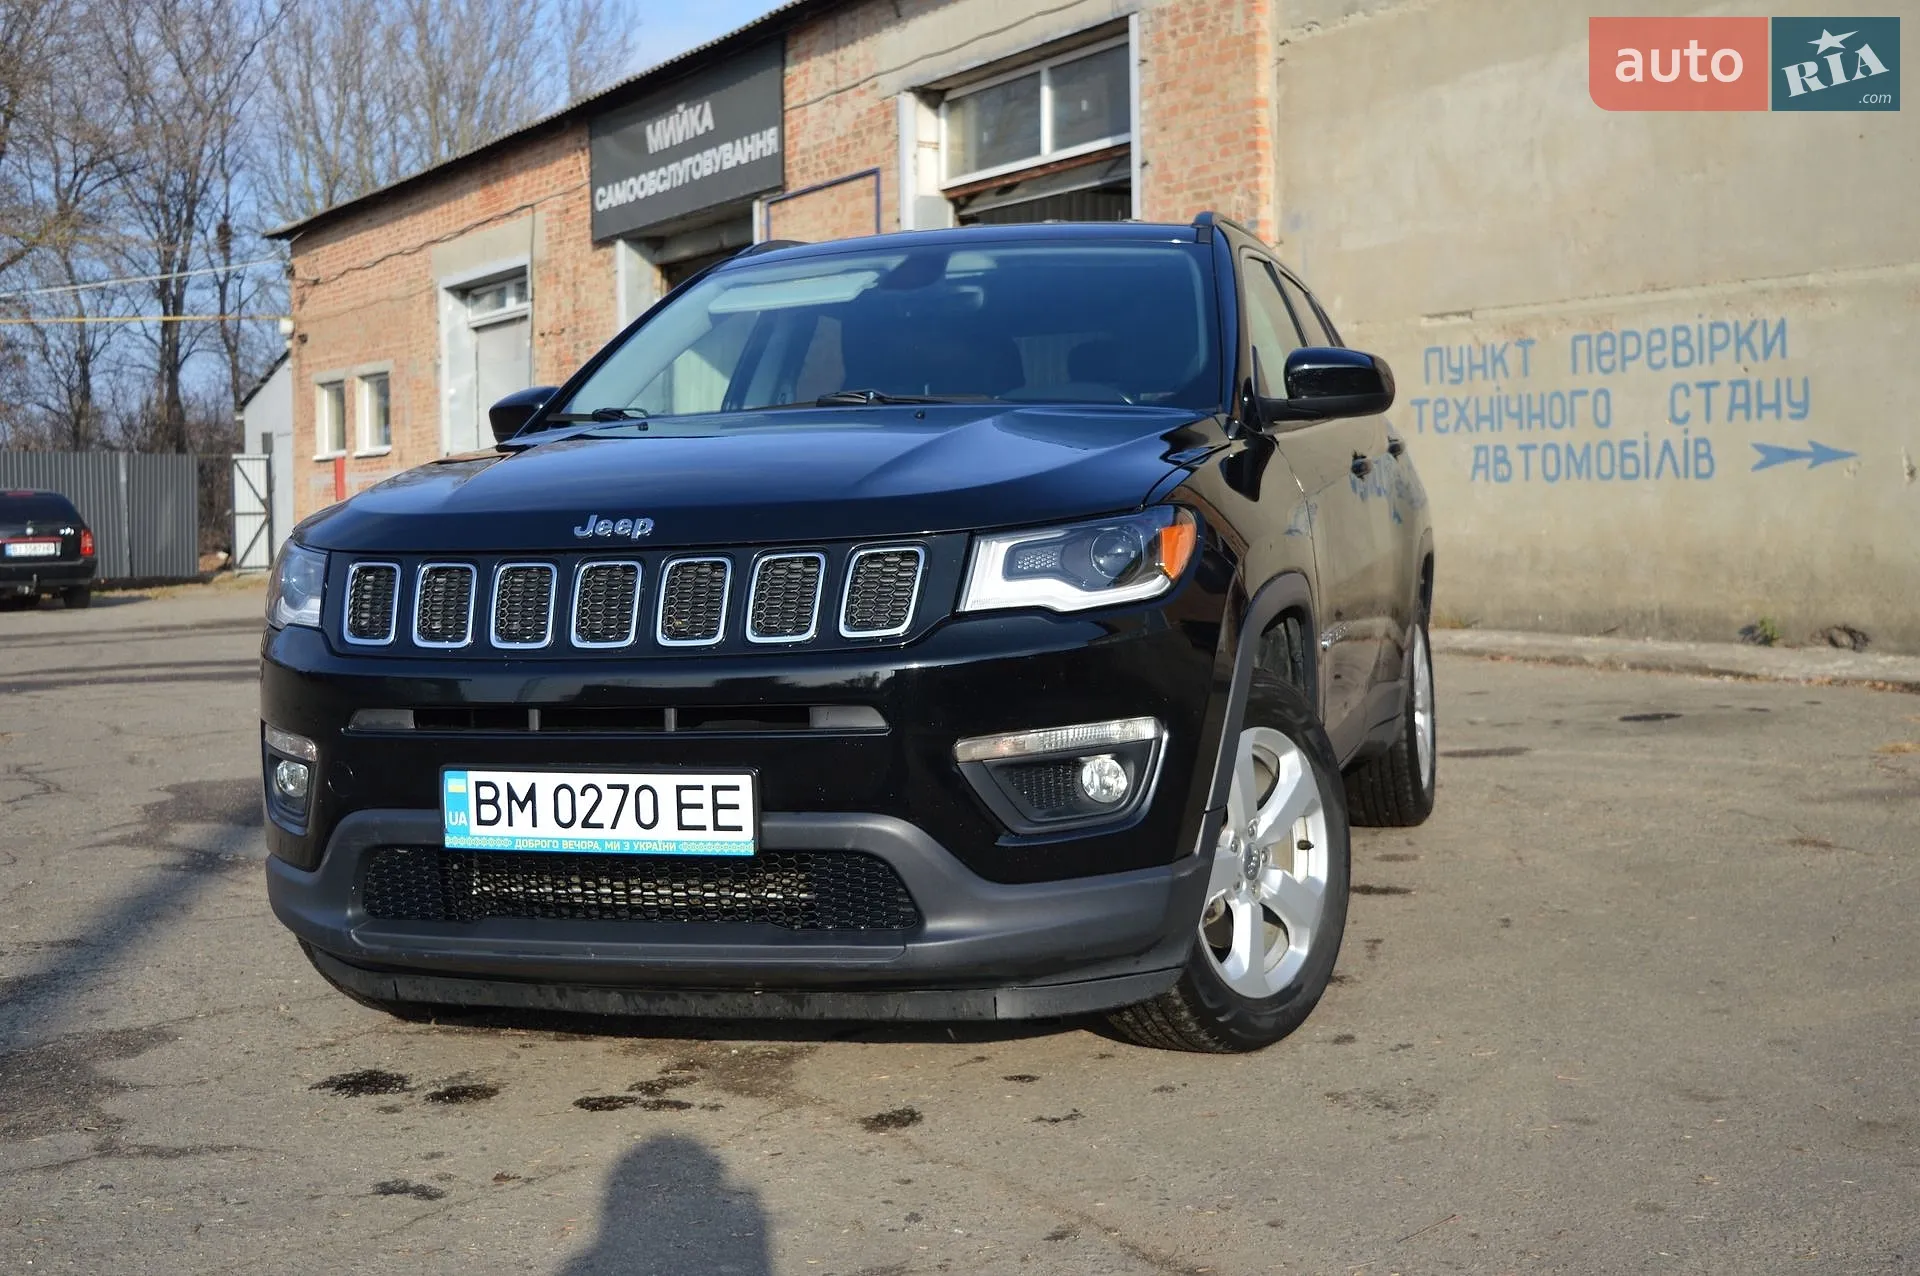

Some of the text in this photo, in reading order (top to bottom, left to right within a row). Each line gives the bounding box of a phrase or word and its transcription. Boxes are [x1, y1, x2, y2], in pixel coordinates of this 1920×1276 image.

[645, 101, 715, 154] МИЙКА
[595, 126, 779, 212] САМООБСЛУГОВУВАННЯ
[1471, 428, 1716, 483] АВТОМОБІЛІВ
[574, 514, 654, 539] Jeep
[450, 810, 468, 826] UA
[474, 780, 744, 832] BM 0270 EE
[515, 838, 559, 850] ДОБРОГО
[604, 840, 621, 851] МИ
[633, 839, 677, 852] УКРАЇНИ
